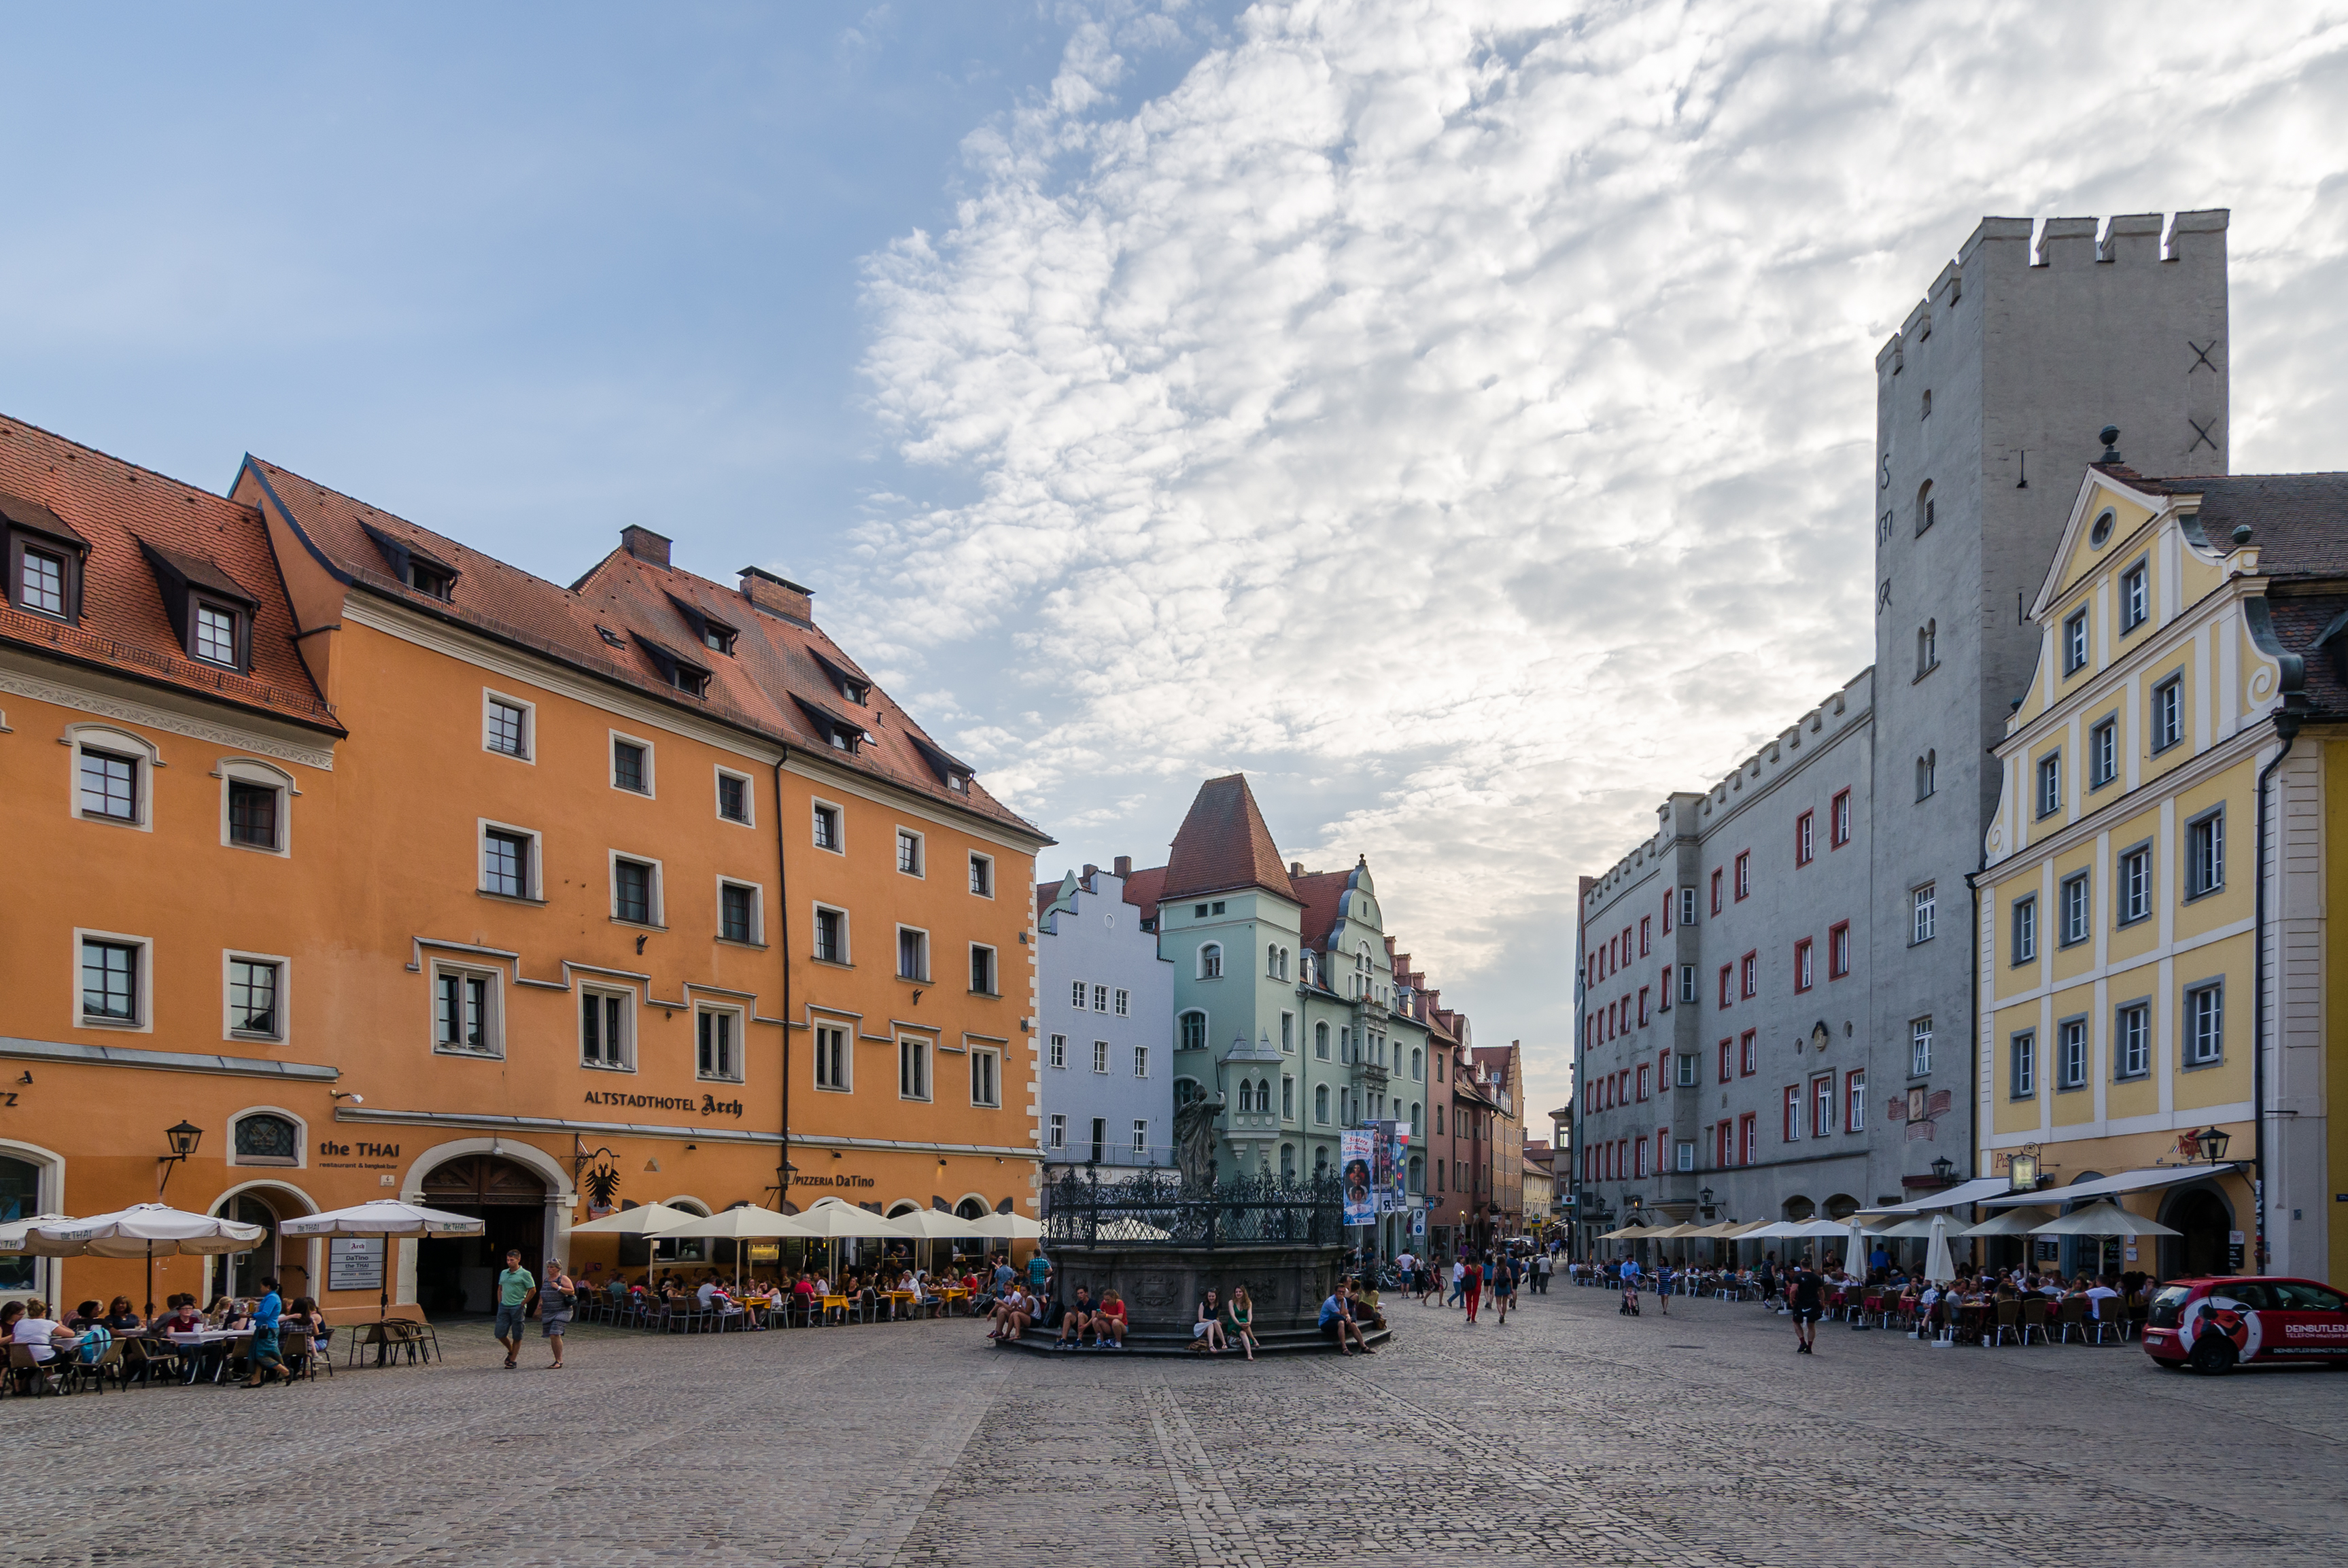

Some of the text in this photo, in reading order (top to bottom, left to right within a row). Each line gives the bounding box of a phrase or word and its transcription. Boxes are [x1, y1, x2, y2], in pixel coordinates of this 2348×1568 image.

[585, 1091, 743, 1119] ALTSTADTHOTEL Arch
[1349, 1136, 1368, 1145] Sisters
[320, 1140, 400, 1157] the THAI
[1353, 1145, 1369, 1153] Swing
[795, 1174, 874, 1187] PIZZERIA DaTino
[451, 1223, 466, 1231] THAI
[72, 1230, 92, 1240] THAI
[351, 1242, 365, 1251] Arch
